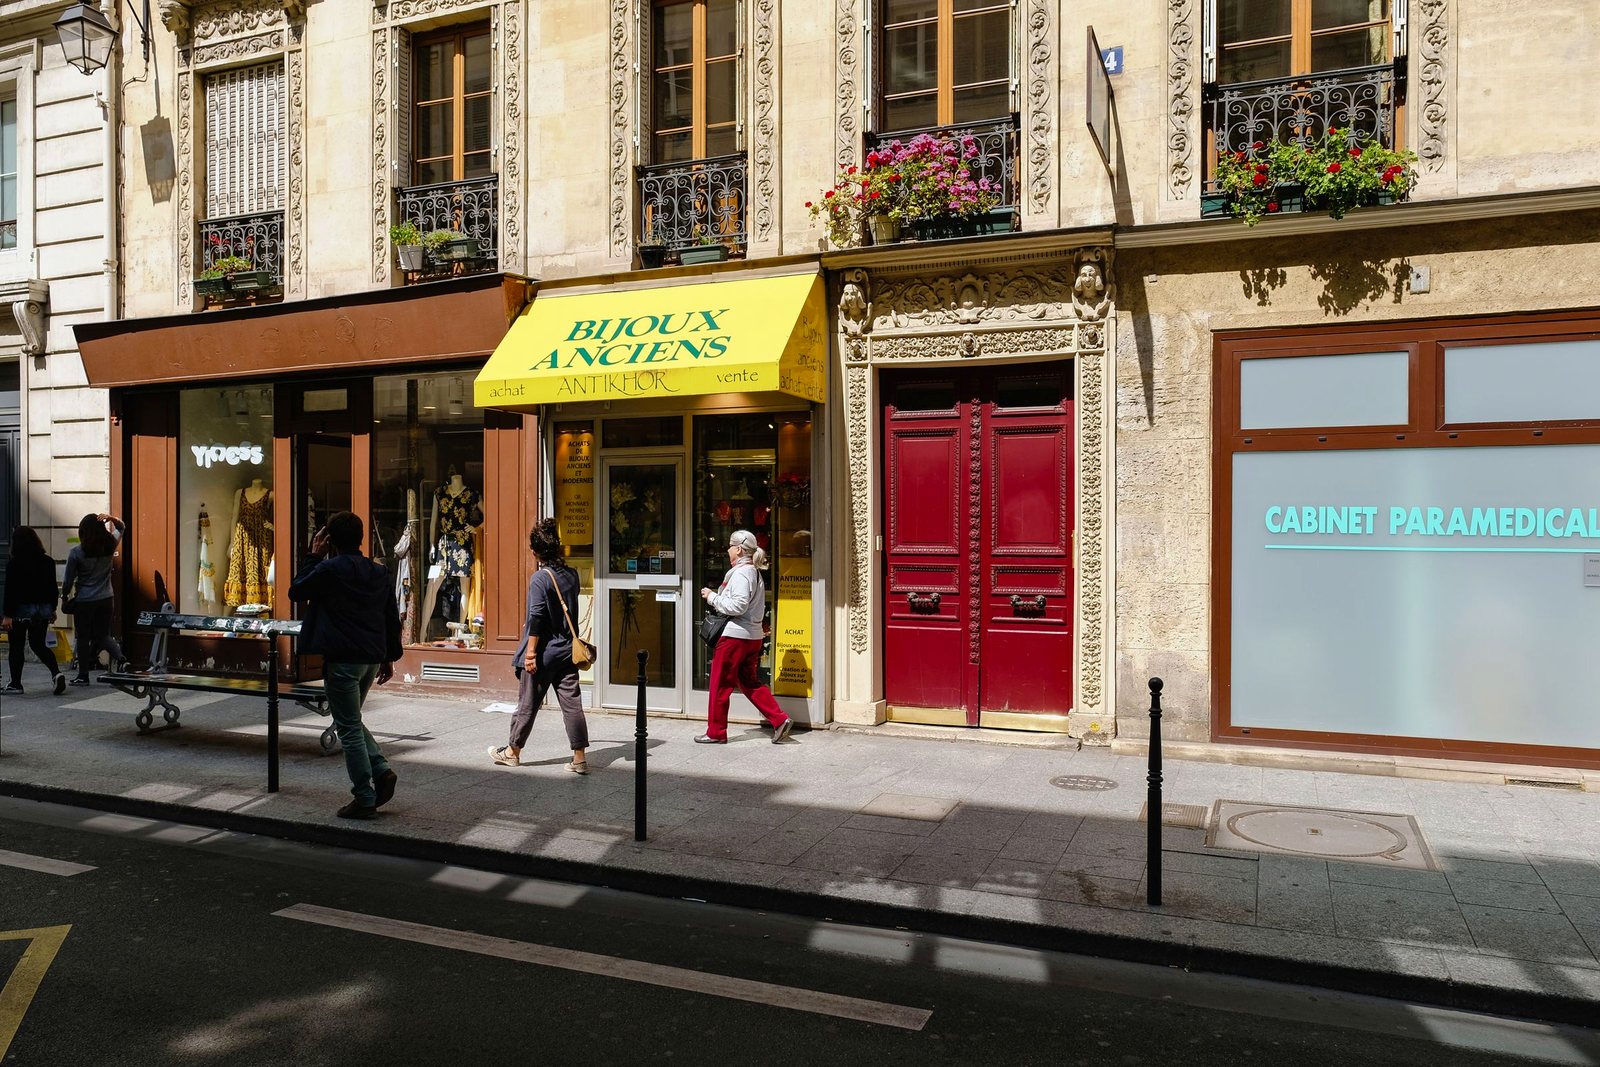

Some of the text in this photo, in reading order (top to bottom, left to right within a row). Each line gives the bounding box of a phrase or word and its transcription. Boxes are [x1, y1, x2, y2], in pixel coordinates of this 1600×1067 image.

[1104, 51, 1118, 71] 4
[563, 308, 730, 344] BIJOUX
[529, 335, 732, 370] ANCIENS
[489, 370, 759, 398] achat ANTIKHOR vente
[1264, 505, 1600, 538] CABINET PARAMEDICAL
